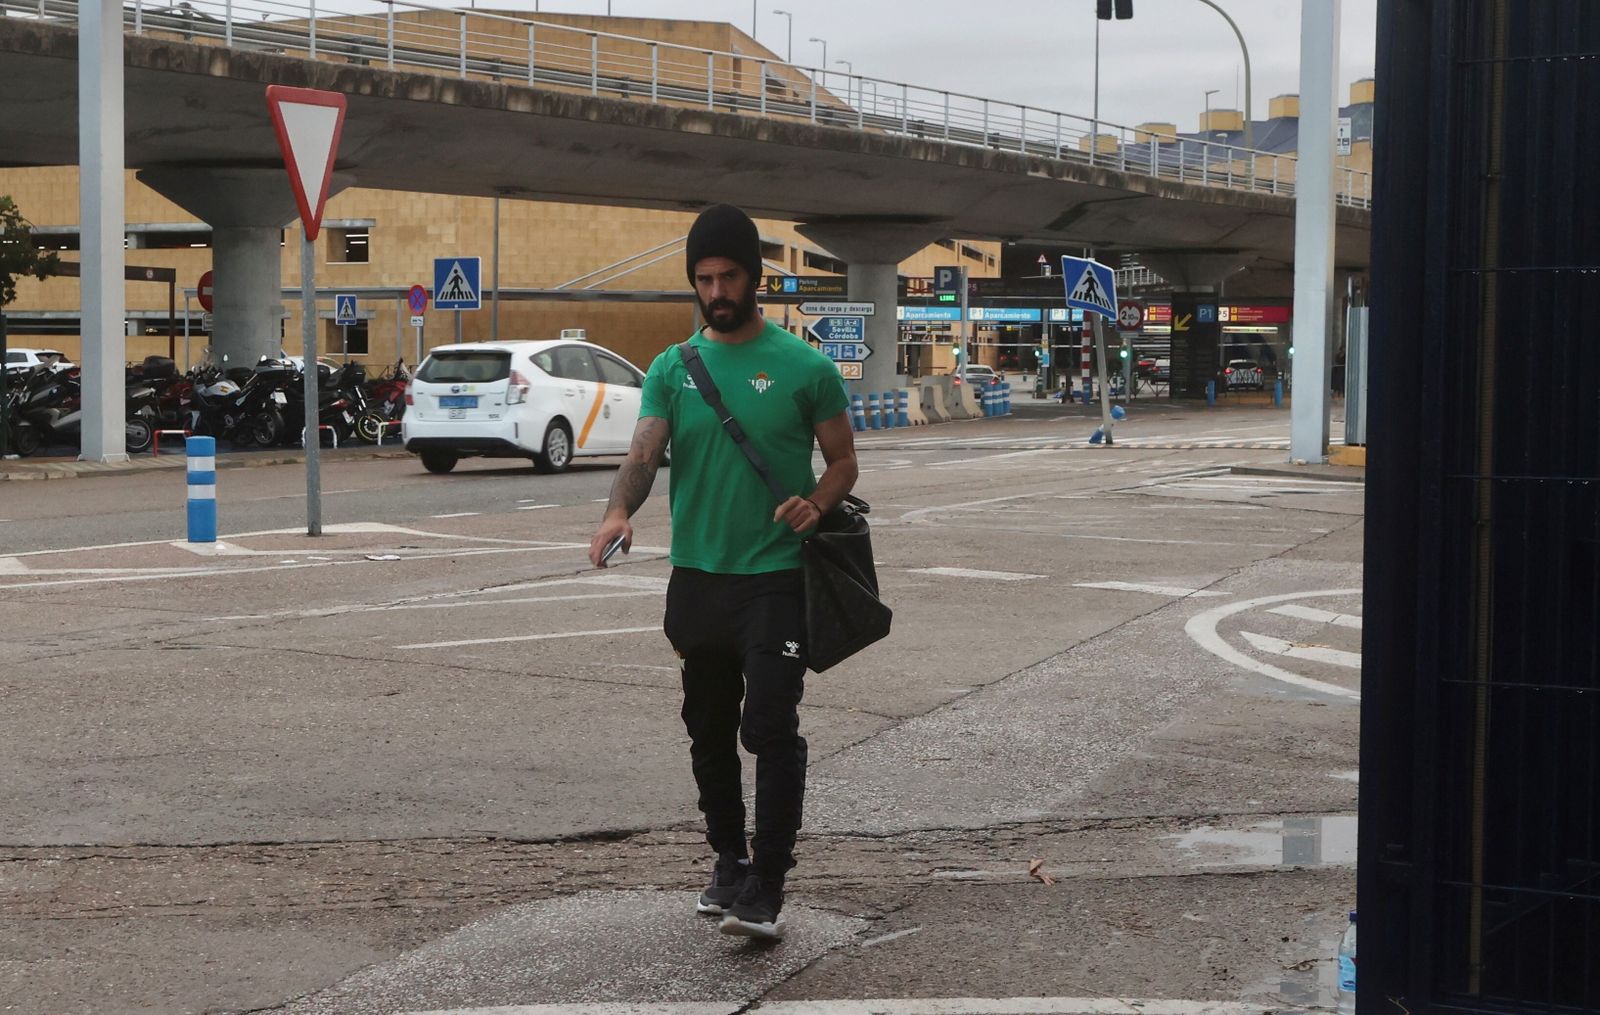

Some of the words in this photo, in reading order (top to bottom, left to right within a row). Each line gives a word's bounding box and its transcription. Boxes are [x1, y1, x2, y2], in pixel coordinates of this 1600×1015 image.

[940, 270, 952, 288] P
[784, 281, 796, 291] P1
[1199, 308, 1213, 319] P1
[824, 346, 837, 356] P1
[843, 365, 858, 376] P2
